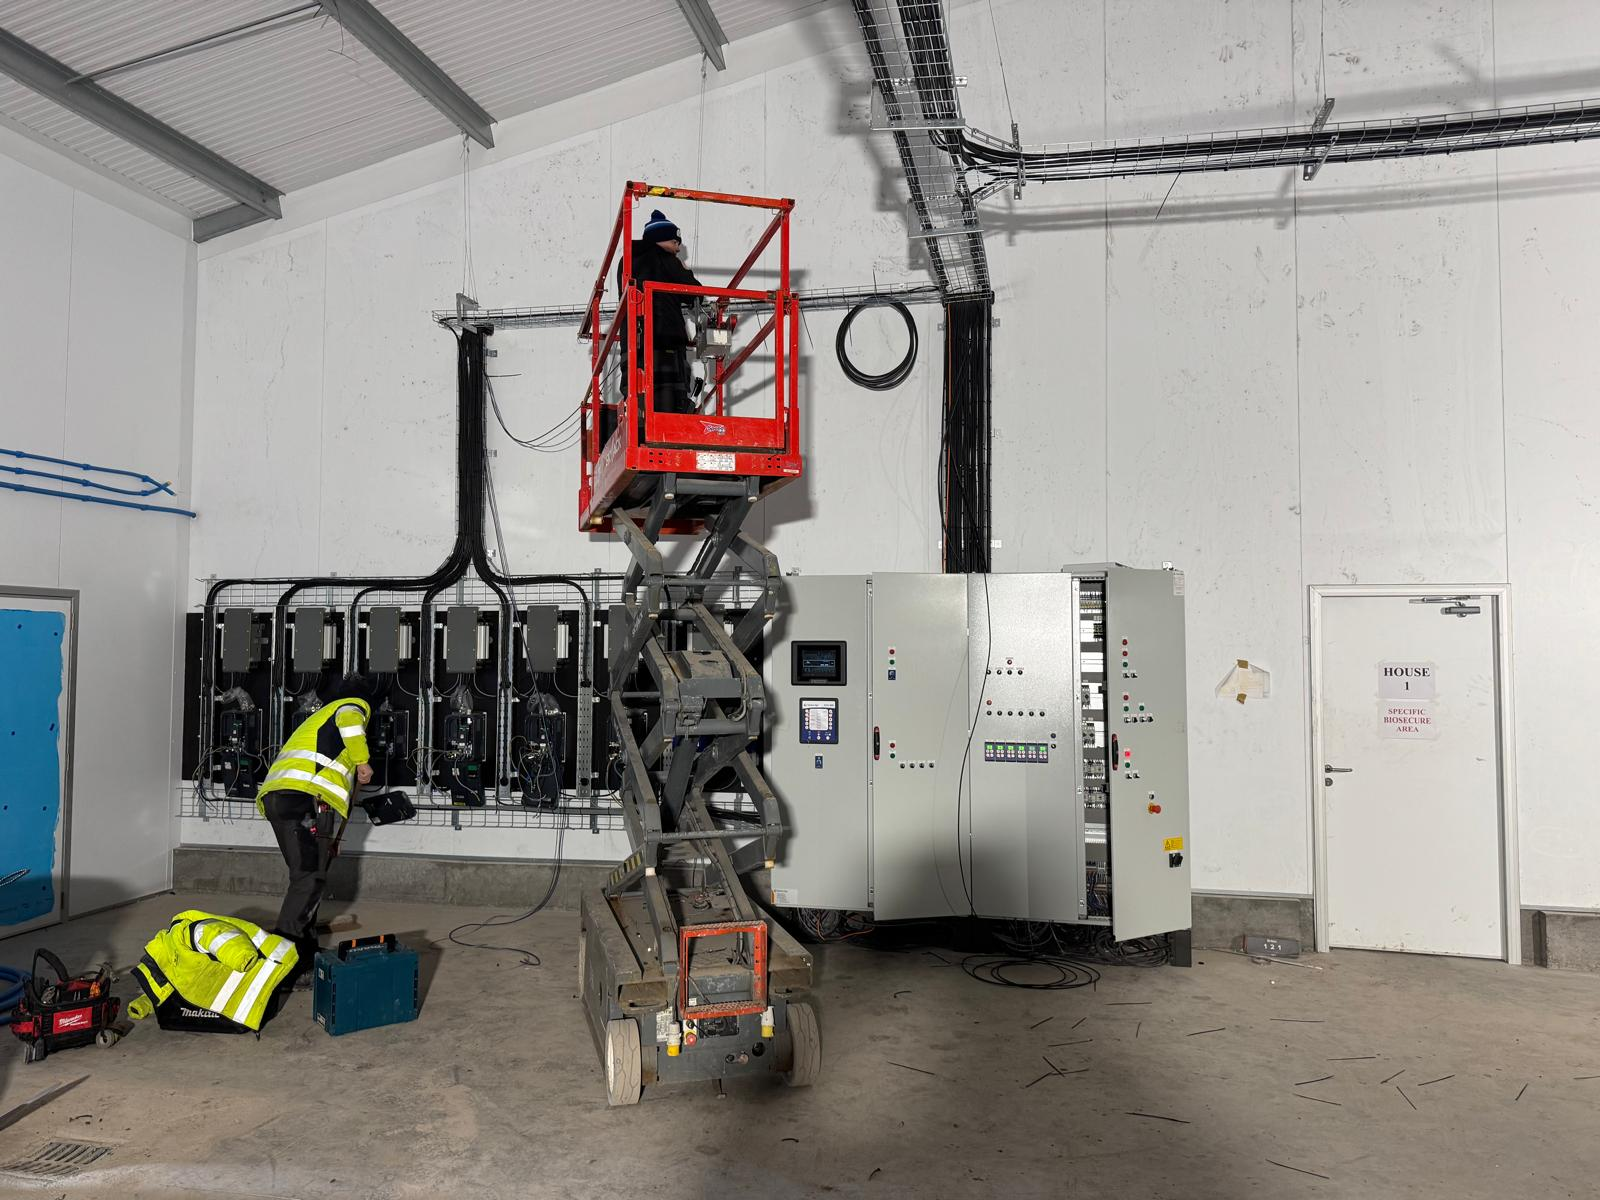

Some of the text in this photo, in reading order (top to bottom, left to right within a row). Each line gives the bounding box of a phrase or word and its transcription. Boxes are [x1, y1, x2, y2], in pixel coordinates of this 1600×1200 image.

[1383, 667, 1431, 677] HOUSE
[1405, 681, 1409, 690] 1
[1384, 716, 1431, 724] BIOSECURE
